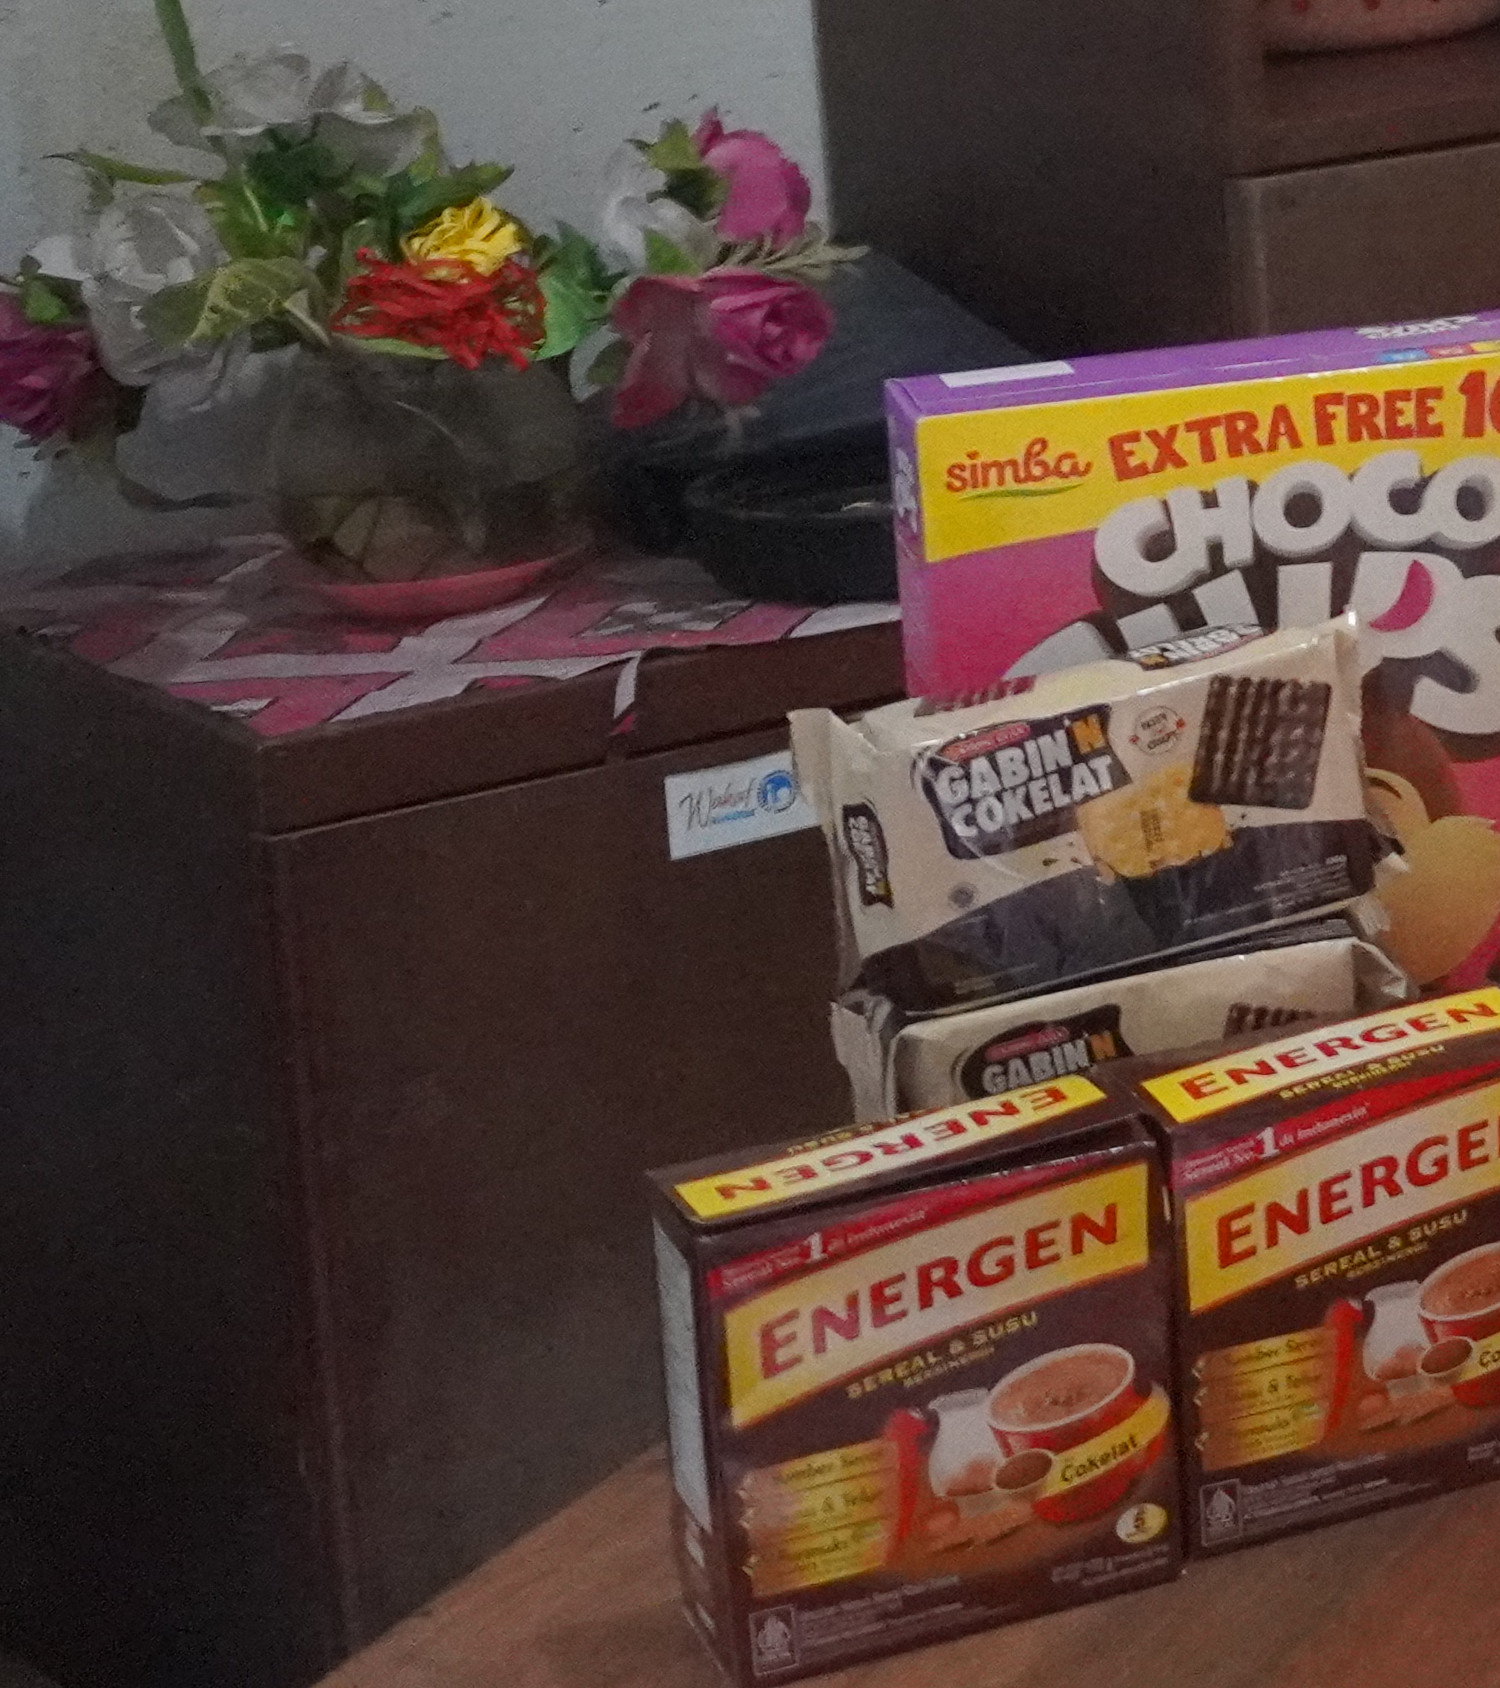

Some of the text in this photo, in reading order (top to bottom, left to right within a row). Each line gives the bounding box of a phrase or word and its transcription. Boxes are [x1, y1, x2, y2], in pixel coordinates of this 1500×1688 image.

[945, 437, 1092, 492] simba
[1109, 403, 1301, 483] EXTRA
[1312, 386, 1446, 447] FREE
[937, 729, 1073, 807] GABIN
[950, 755, 1113, 837] COKELAT
[982, 1043, 1093, 1096] GABIN
[1178, 1001, 1499, 1100] ENERGEN
[717, 1085, 1068, 1202] ENERGEN
[1255, 1126, 1280, 1159] 1
[803, 1231, 828, 1262] 1
[1293, 1244, 1384, 1290] SEREAL
[1408, 1209, 1469, 1243] SUSU
[759, 1204, 1119, 1381] ENERGEN
[845, 1349, 943, 1400] SEREAL
[971, 1310, 1039, 1347] SUSU
[1060, 1433, 1139, 1484] Cokelat
